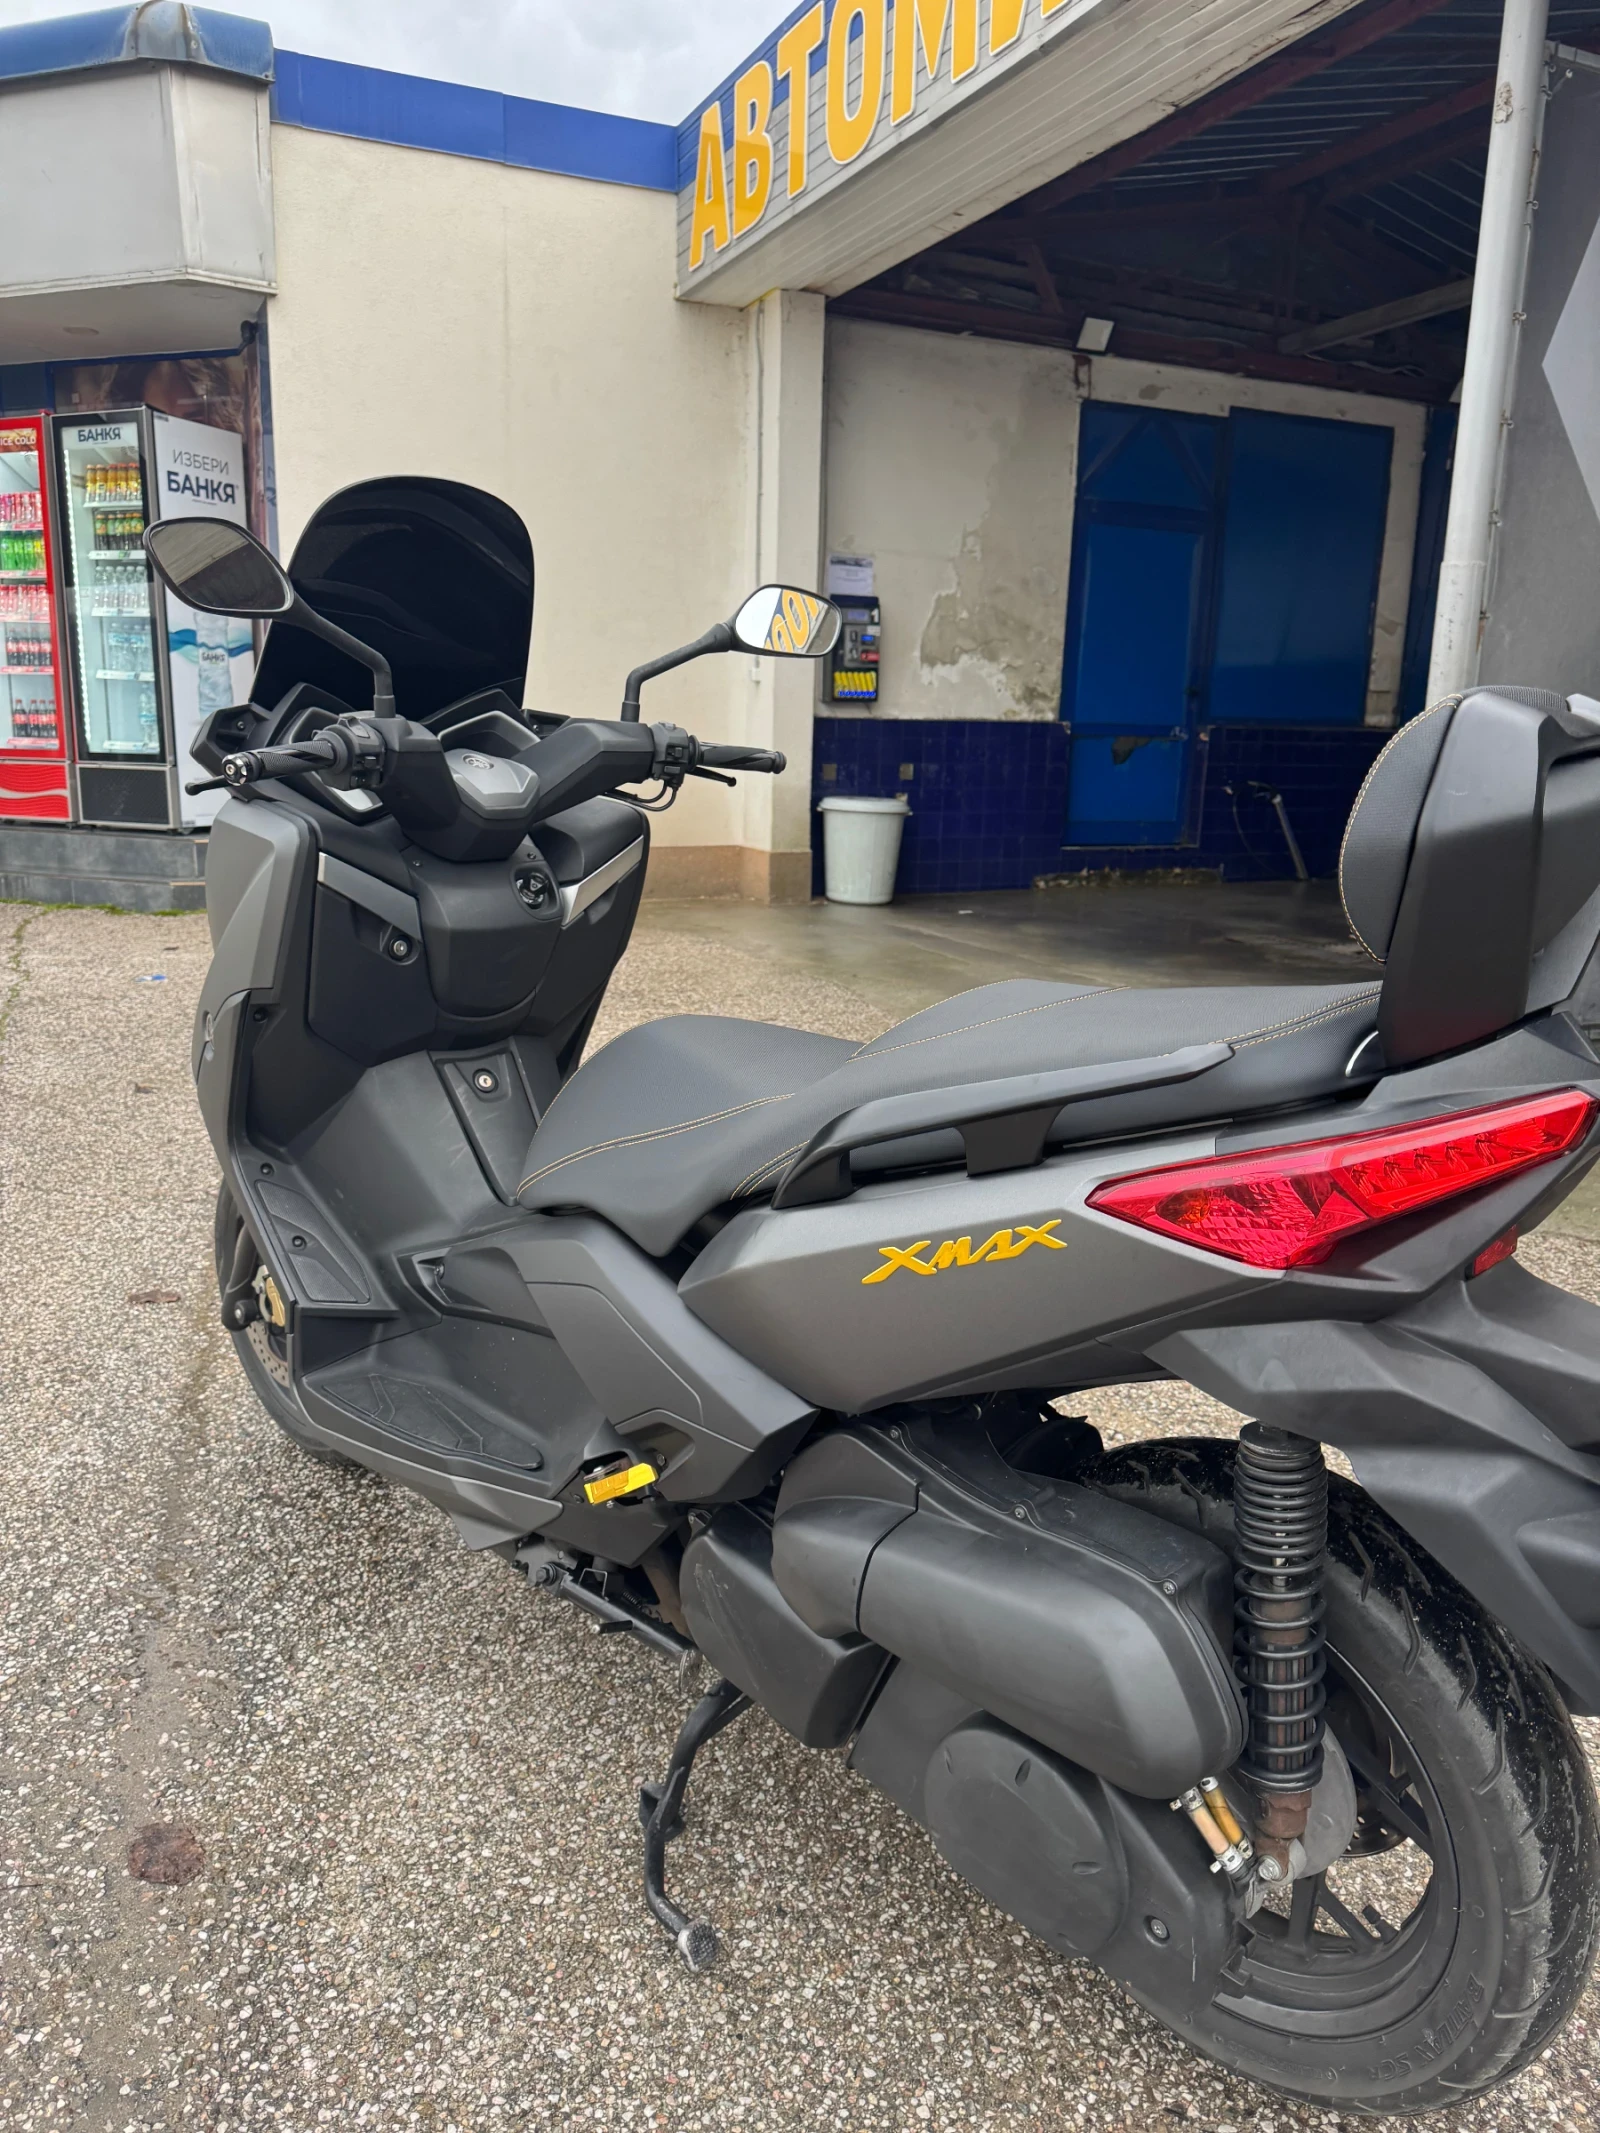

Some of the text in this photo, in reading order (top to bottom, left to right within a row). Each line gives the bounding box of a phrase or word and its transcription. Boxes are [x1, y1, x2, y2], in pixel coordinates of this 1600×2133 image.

[688, 0, 1069, 272] АВТОМ
[0, 436, 37, 447] ICE COLD
[77, 426, 121, 443] БАНКЯ
[172, 448, 230, 476] ИЗБЕРИ
[166, 469, 237, 506] БАНКЯ
[871, 607, 880, 623] 1
[861, 1218, 1068, 1285] XMAX
